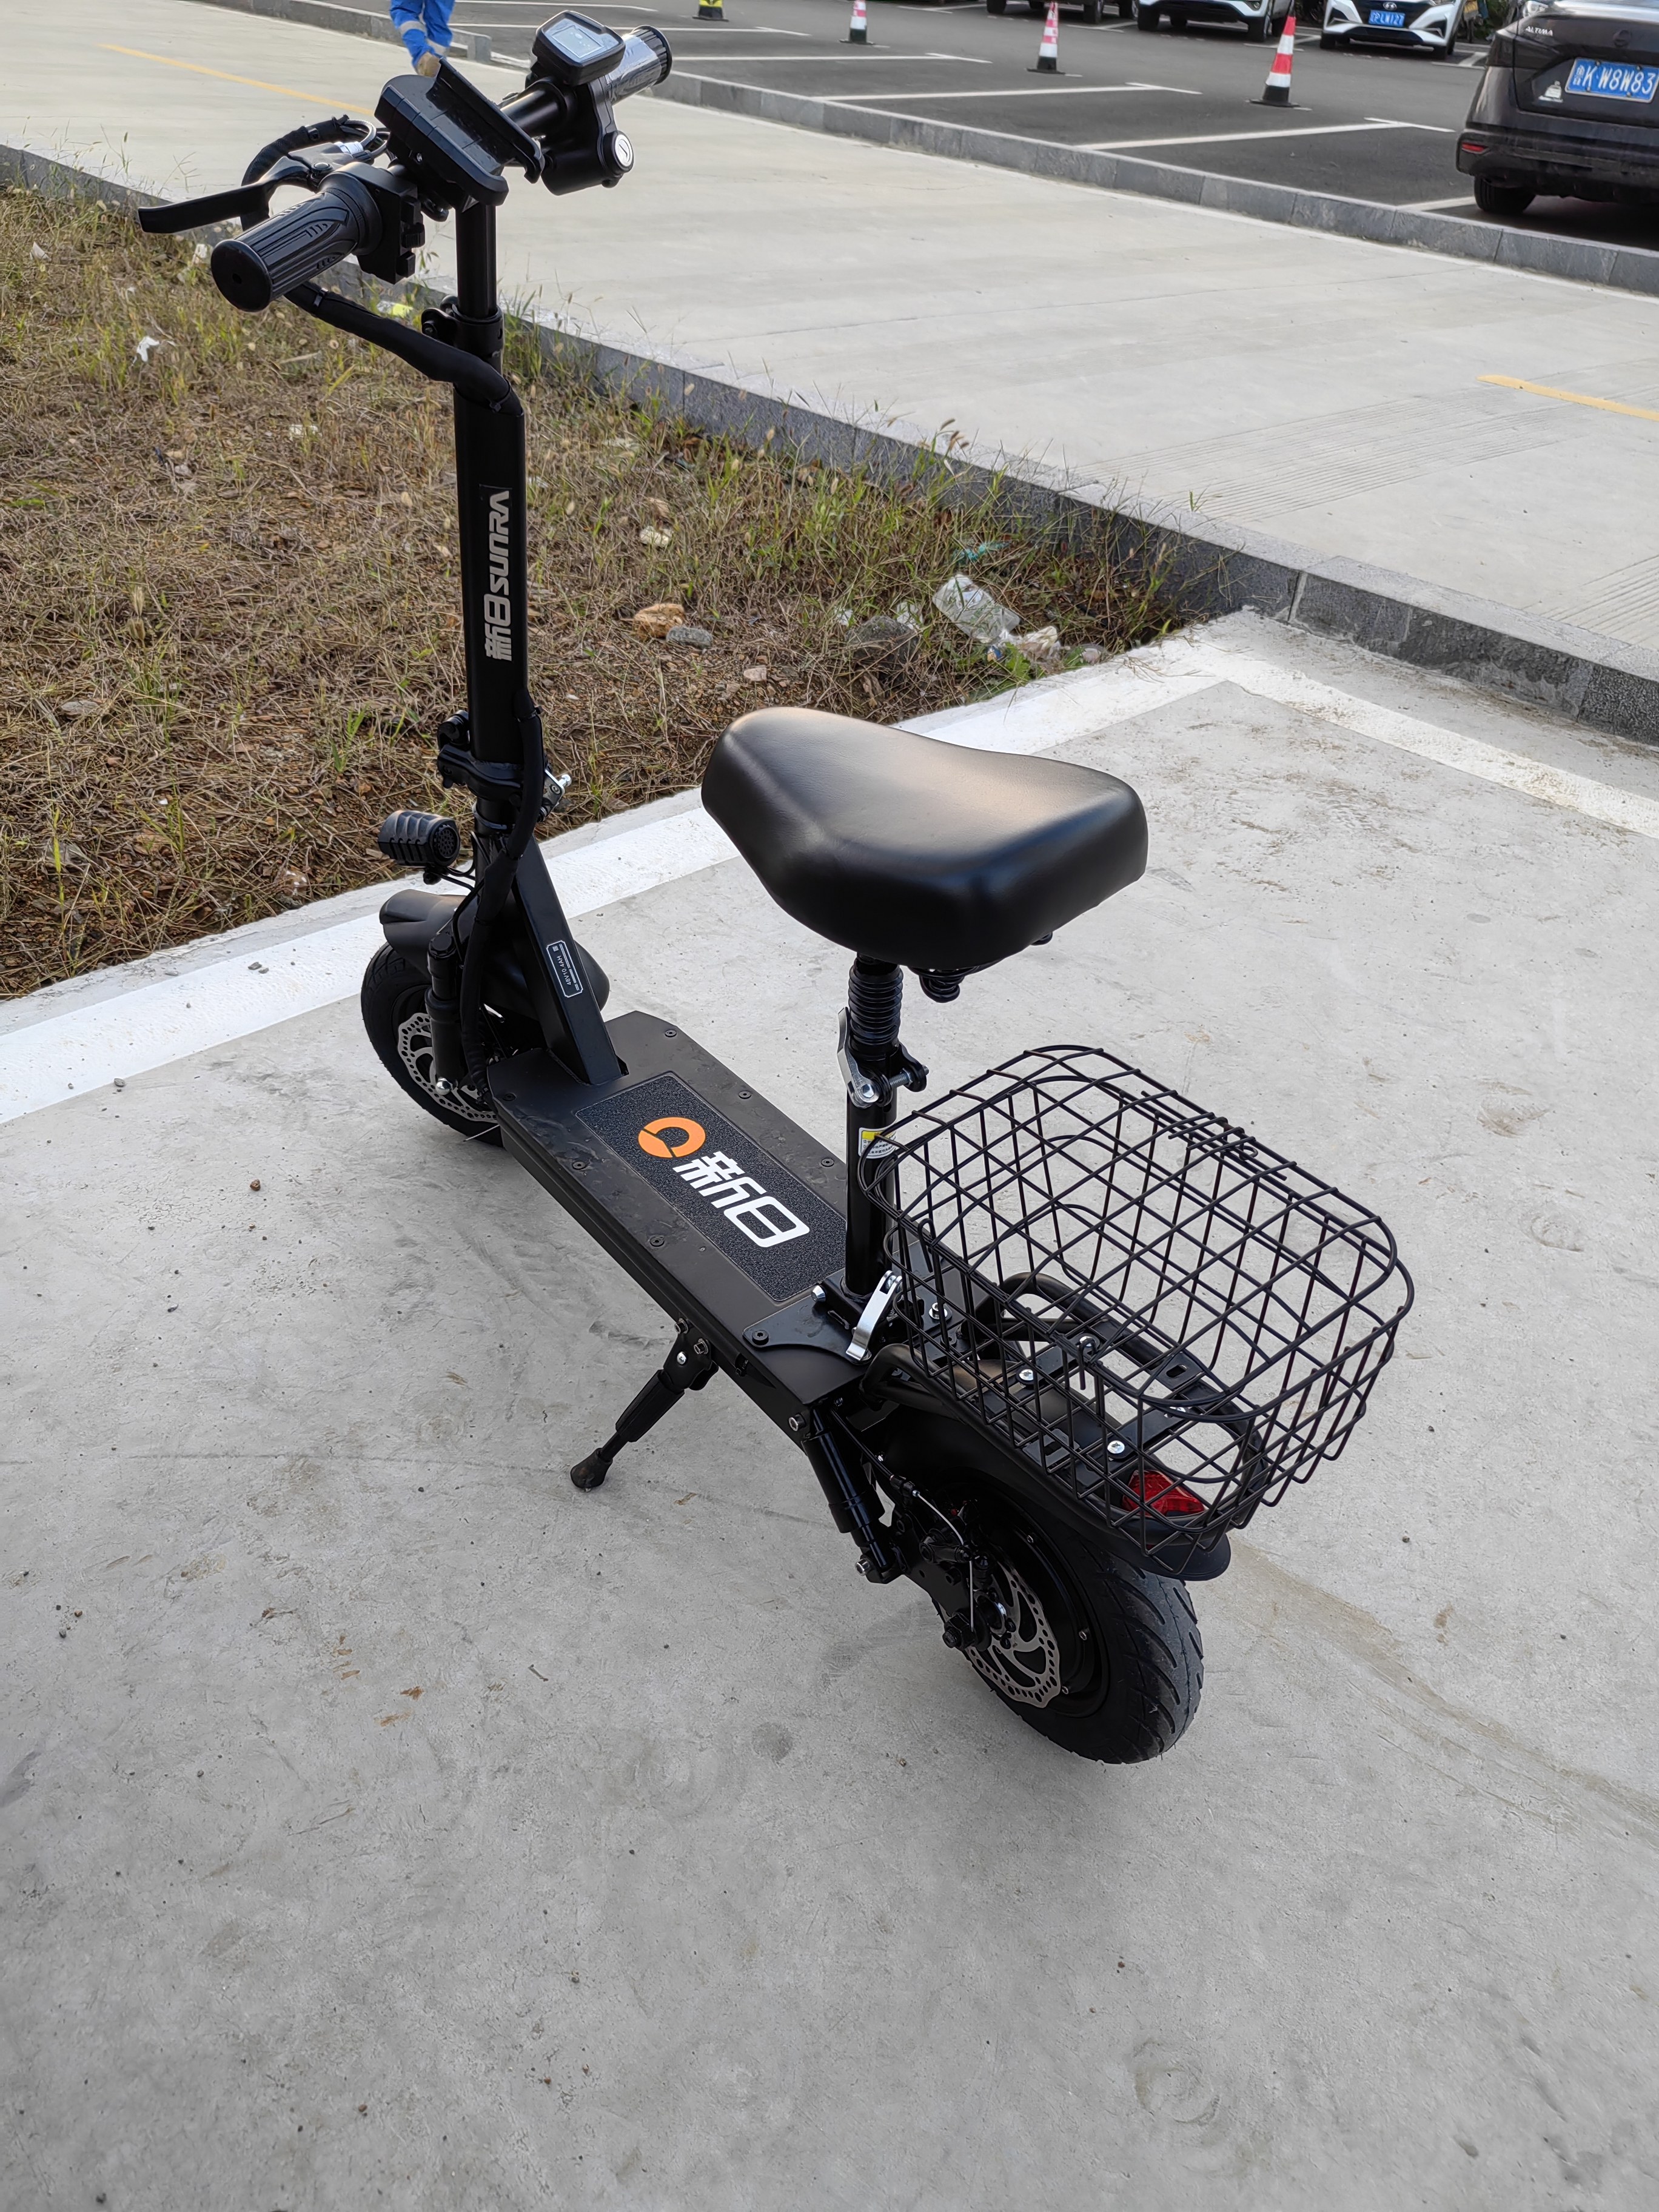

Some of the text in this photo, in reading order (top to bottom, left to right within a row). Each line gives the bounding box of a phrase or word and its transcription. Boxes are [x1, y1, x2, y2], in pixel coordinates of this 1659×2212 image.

[489, 491, 509, 596] SUNRA
[557, 955, 572, 986] 48V10.4AH
[672, 1151, 810, 1248] 新日
